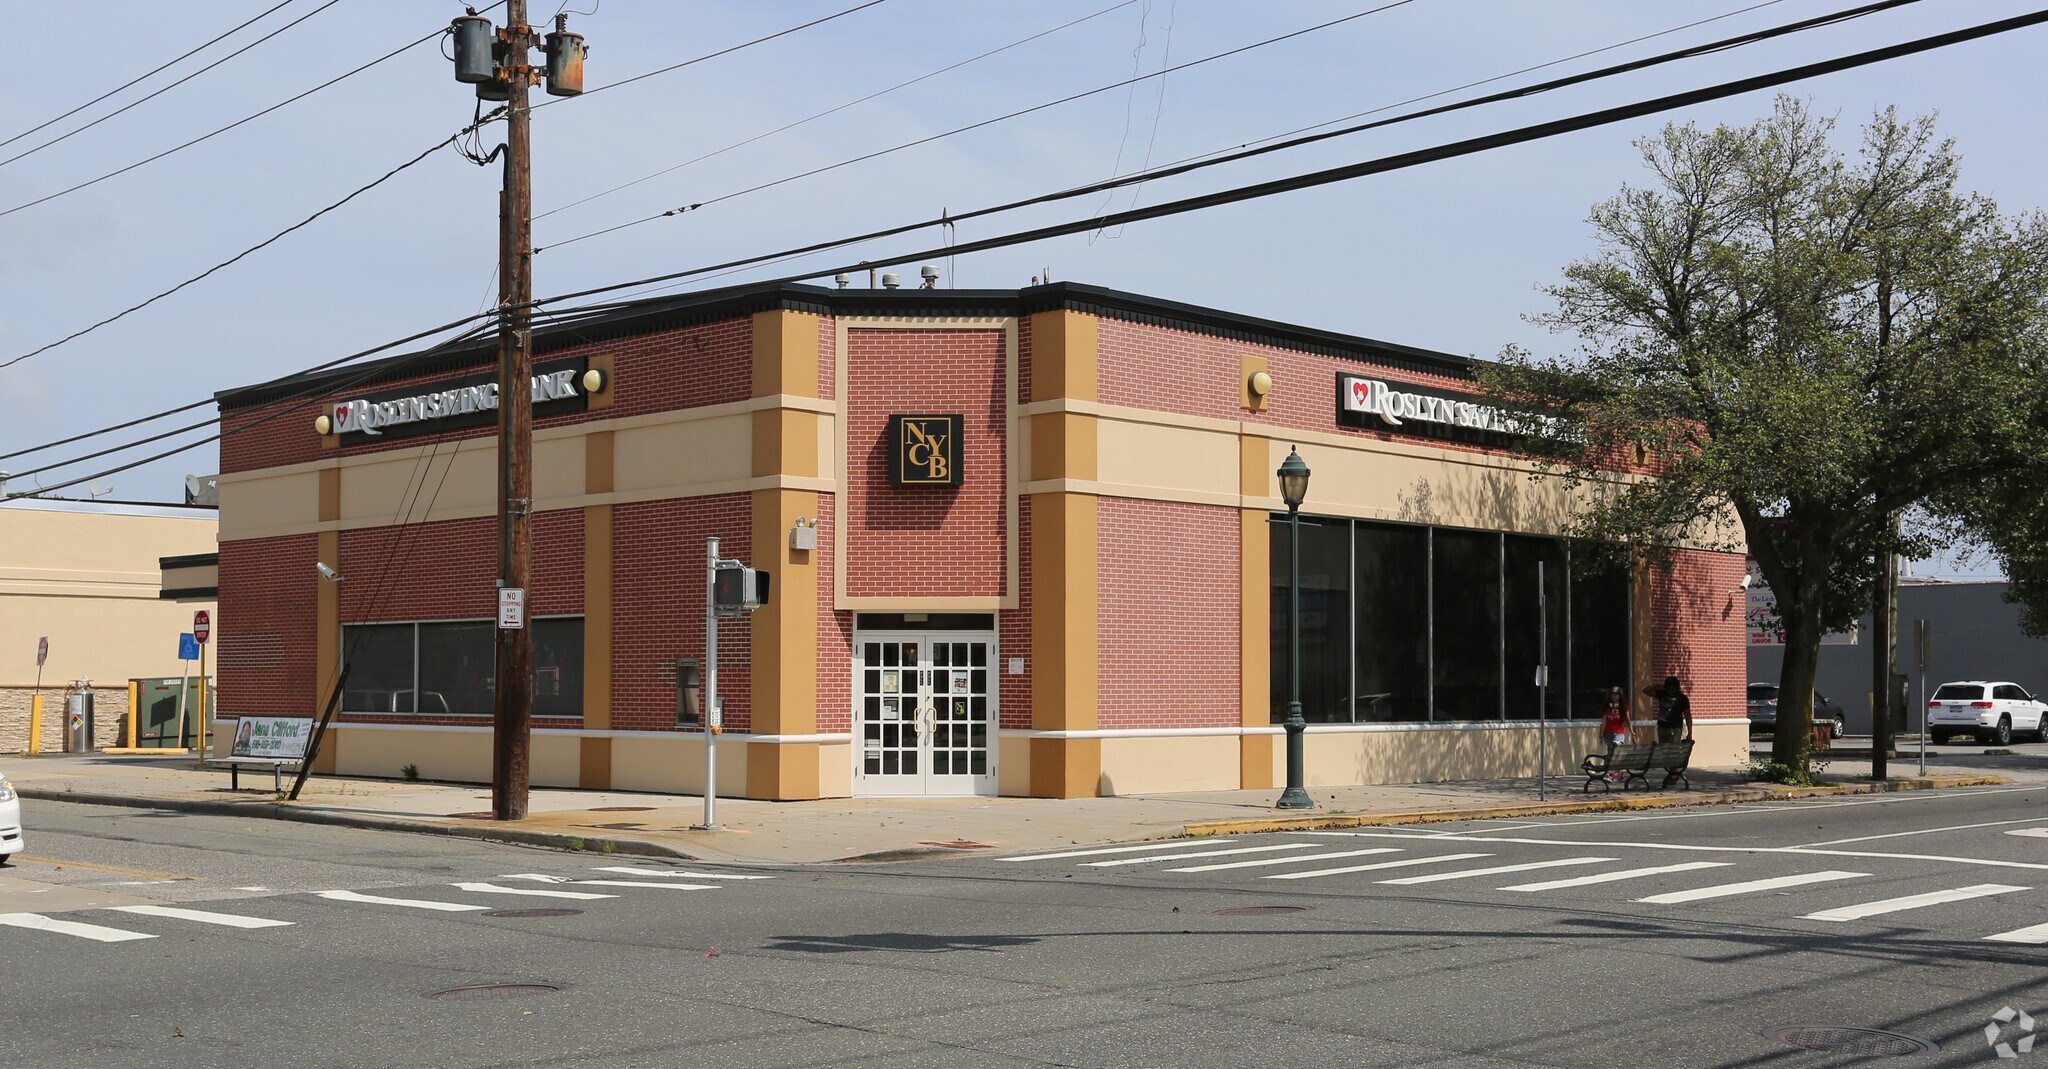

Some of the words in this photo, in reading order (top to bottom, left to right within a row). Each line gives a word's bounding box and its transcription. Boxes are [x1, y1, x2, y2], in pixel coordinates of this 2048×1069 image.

[348, 400, 428, 436] ROSLYN
[427, 382, 500, 419] SAVING
[1370, 380, 1456, 425] ROSLYN
[1454, 401, 1535, 435] SAVI
[506, 592, 516, 600] NO
